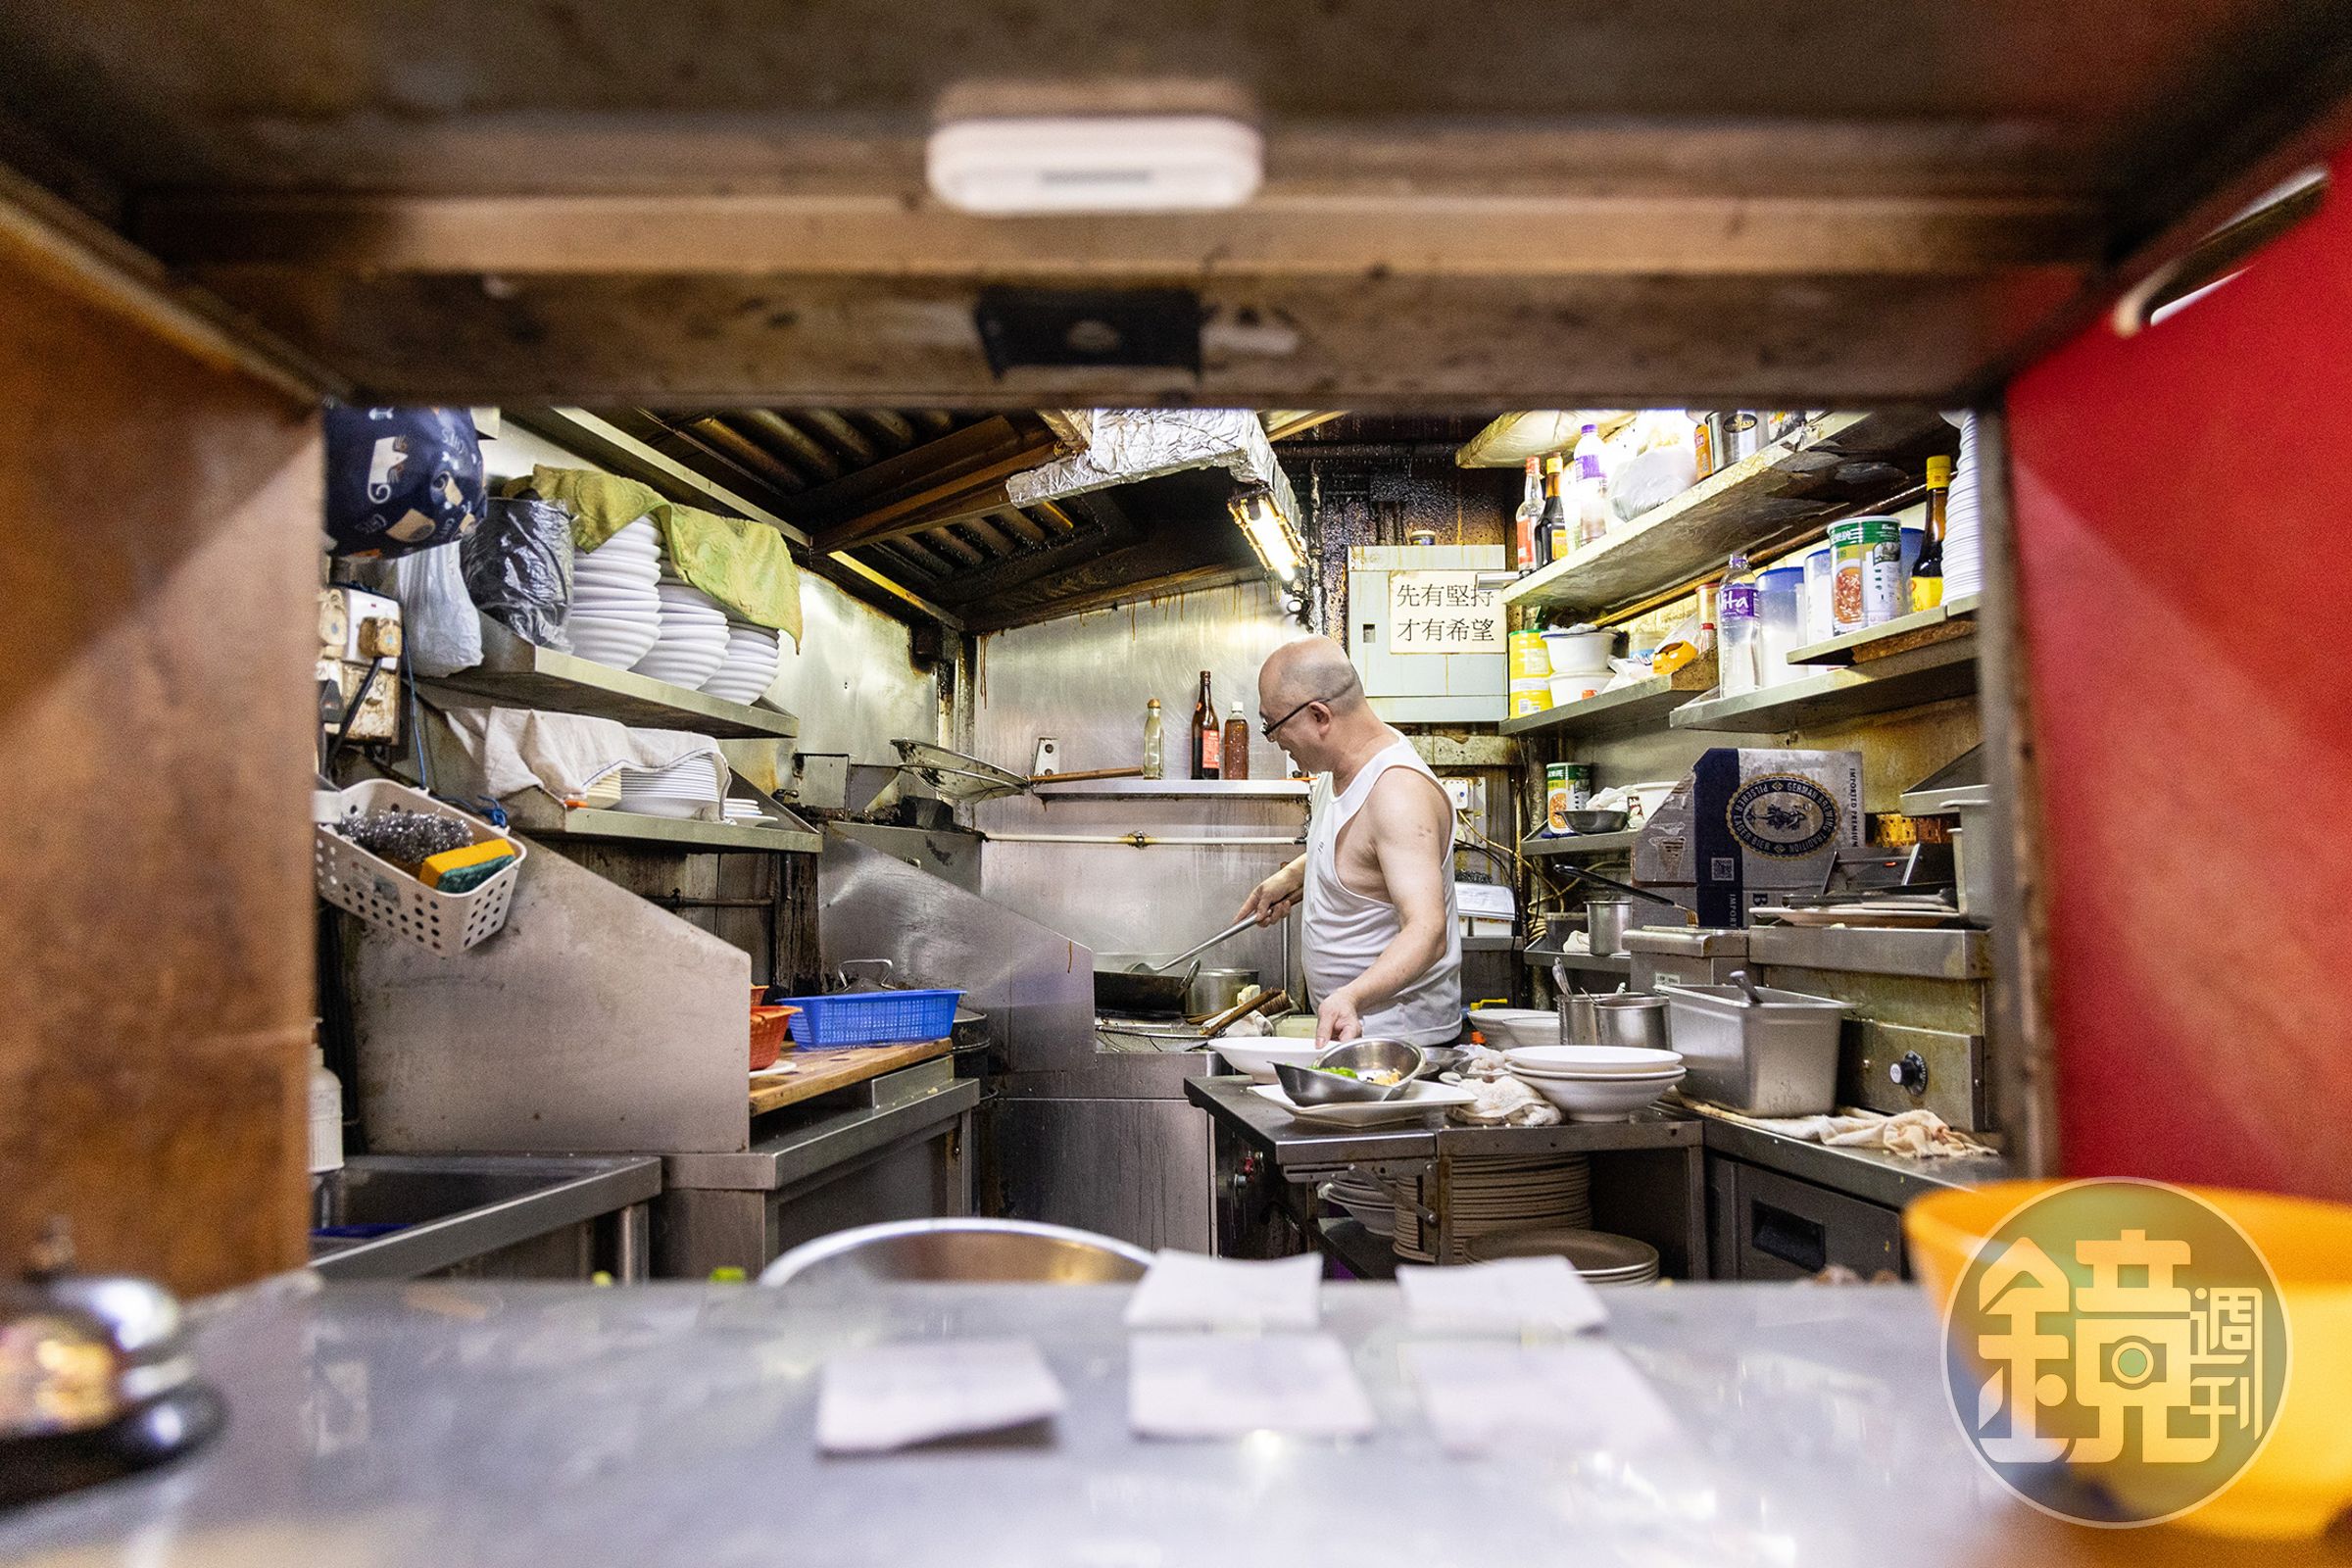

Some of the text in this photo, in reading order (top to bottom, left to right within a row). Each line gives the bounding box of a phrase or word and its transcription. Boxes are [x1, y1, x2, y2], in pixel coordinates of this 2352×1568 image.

[1396, 583, 1494, 607] 先有堅持
[1396, 617, 1495, 642] 才有希望
[1733, 783, 1772, 852] PILSENER LAGER BIER
[1787, 782, 1835, 853] GERMAN BREWING TRADITION
